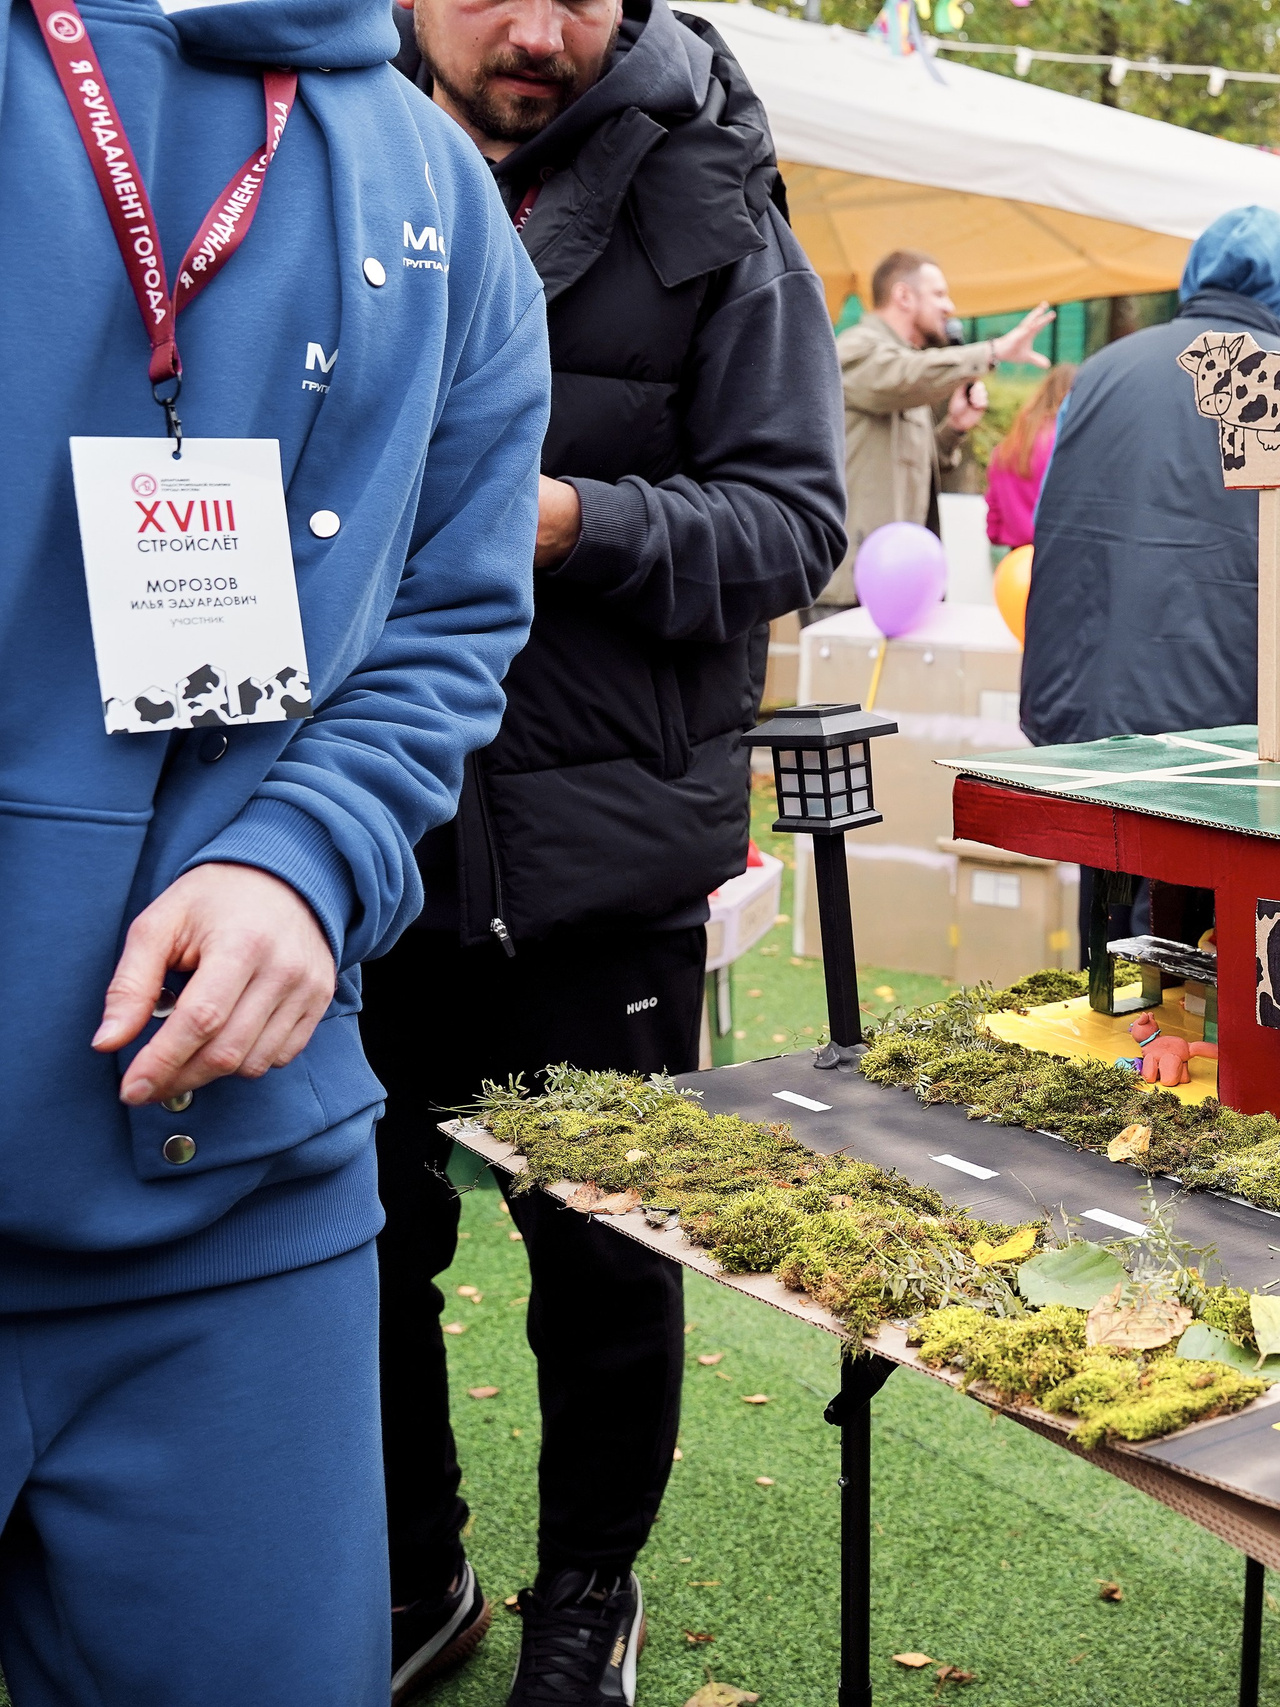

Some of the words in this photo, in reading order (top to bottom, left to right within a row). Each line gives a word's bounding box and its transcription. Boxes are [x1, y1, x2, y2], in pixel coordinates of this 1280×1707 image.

[69, 60, 94, 74] Я
[79, 79, 148, 222] ФУНДАМЕНТ
[179, 271, 195, 289] Я
[192, 174, 262, 272] ФУНДАМЕНТ
[129, 225, 166, 325] ГОРОДА
[135, 500, 236, 533] XVIII
[137, 534, 239, 553] СТРОЙСЛЁТ
[146, 577, 238, 593] МОРОЗОВ
[130, 599, 165, 611] ИЛЬЯ
[168, 595, 258, 609] ЭДУАРДОВИЧ
[626, 996, 658, 1015] HUGO
